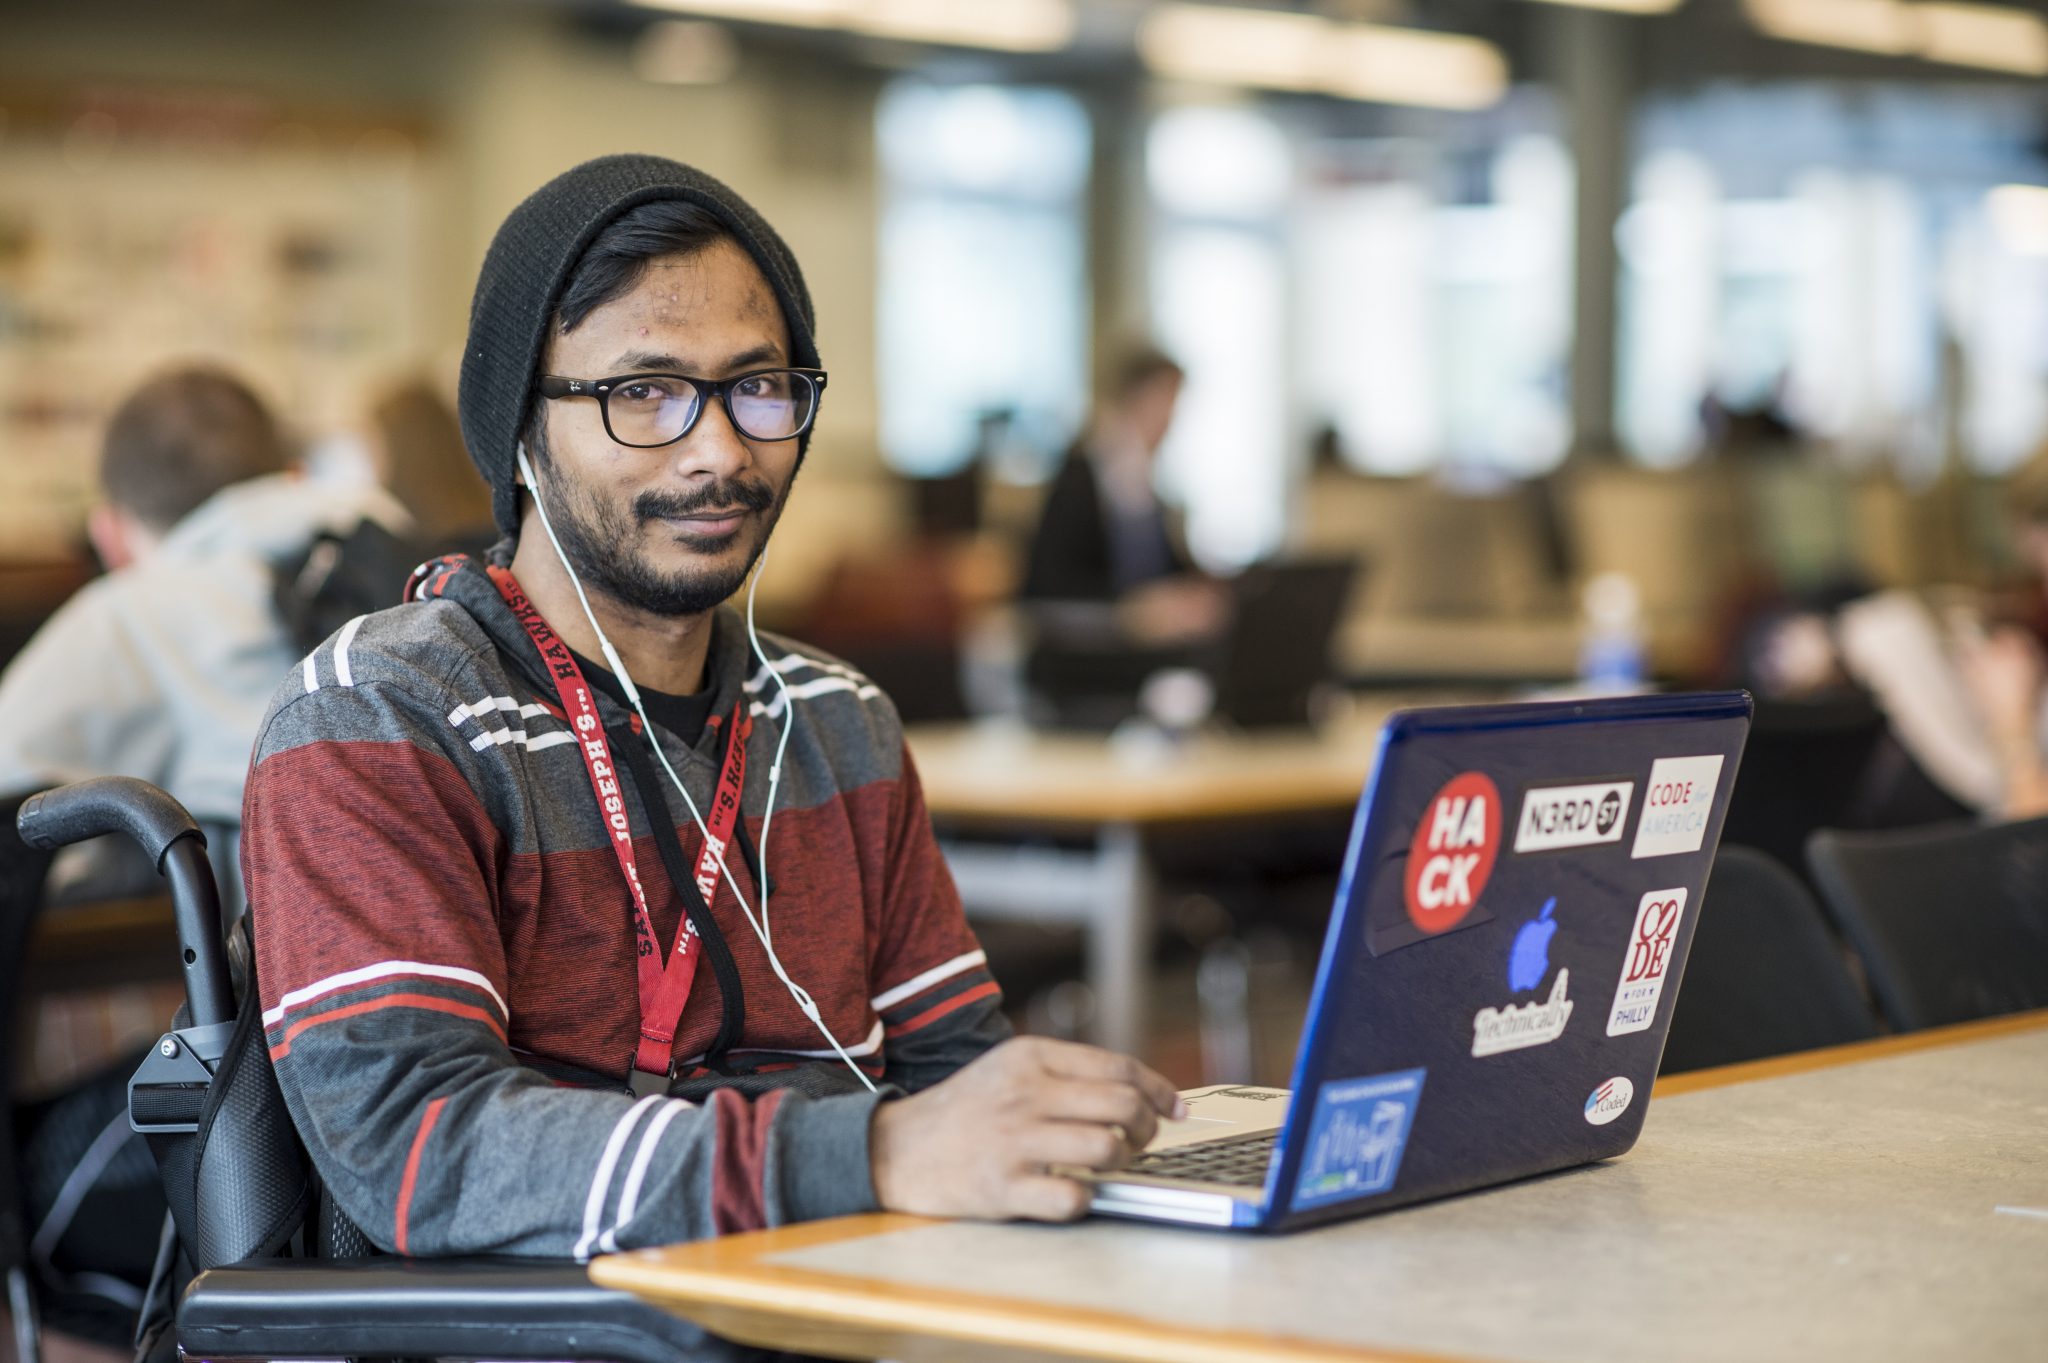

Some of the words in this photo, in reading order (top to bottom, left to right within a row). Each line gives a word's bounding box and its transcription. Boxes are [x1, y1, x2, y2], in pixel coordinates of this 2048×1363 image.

[1650, 781, 1693, 807] CODE
[1427, 794, 1486, 850] HA
[1525, 799, 1593, 836] N3RD
[1598, 800, 1620, 826] ST
[1643, 812, 1704, 834] AMERICA
[1417, 853, 1480, 910] CK
[1625, 937, 1670, 983] DE
[1631, 988, 1647, 1000] FOR
[1614, 1005, 1652, 1027] PHILLY
[1600, 1092, 1628, 1113] Coded
